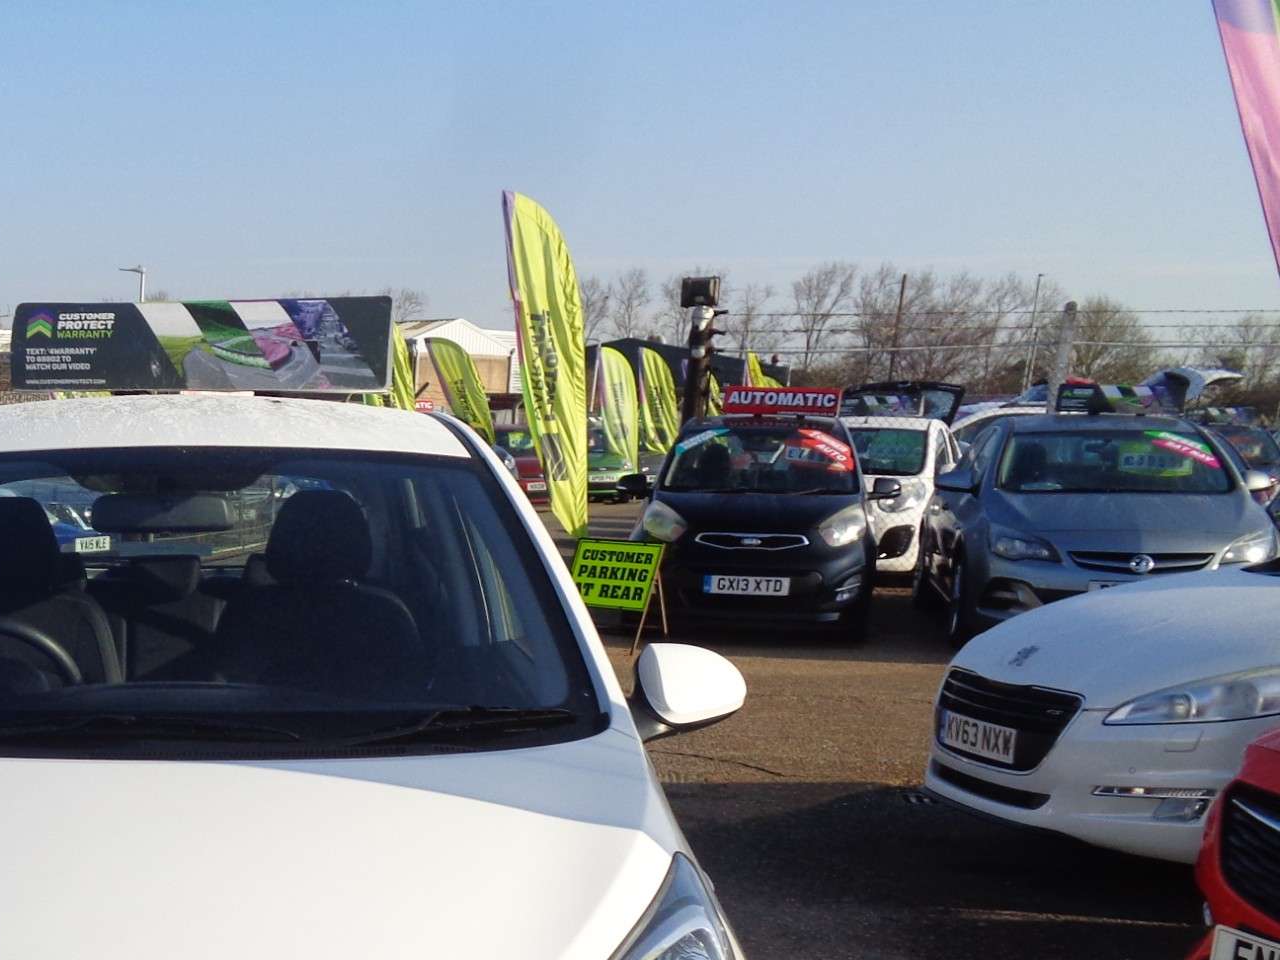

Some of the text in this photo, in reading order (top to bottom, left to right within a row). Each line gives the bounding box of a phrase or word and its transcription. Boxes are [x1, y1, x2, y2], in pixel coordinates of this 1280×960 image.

[57, 320, 114, 329] PROTECT
[57, 330, 113, 338] WARRANTY
[727, 390, 836, 408] AUTOMATIC
[815, 444, 848, 461] AUTO
[582, 549, 654, 565] CUSTOMER
[578, 565, 649, 582] PARKING
[598, 584, 644, 601] REAR
[717, 578, 749, 591] GX13
[754, 580, 783, 592] XTD
[981, 725, 1013, 757] NXW
